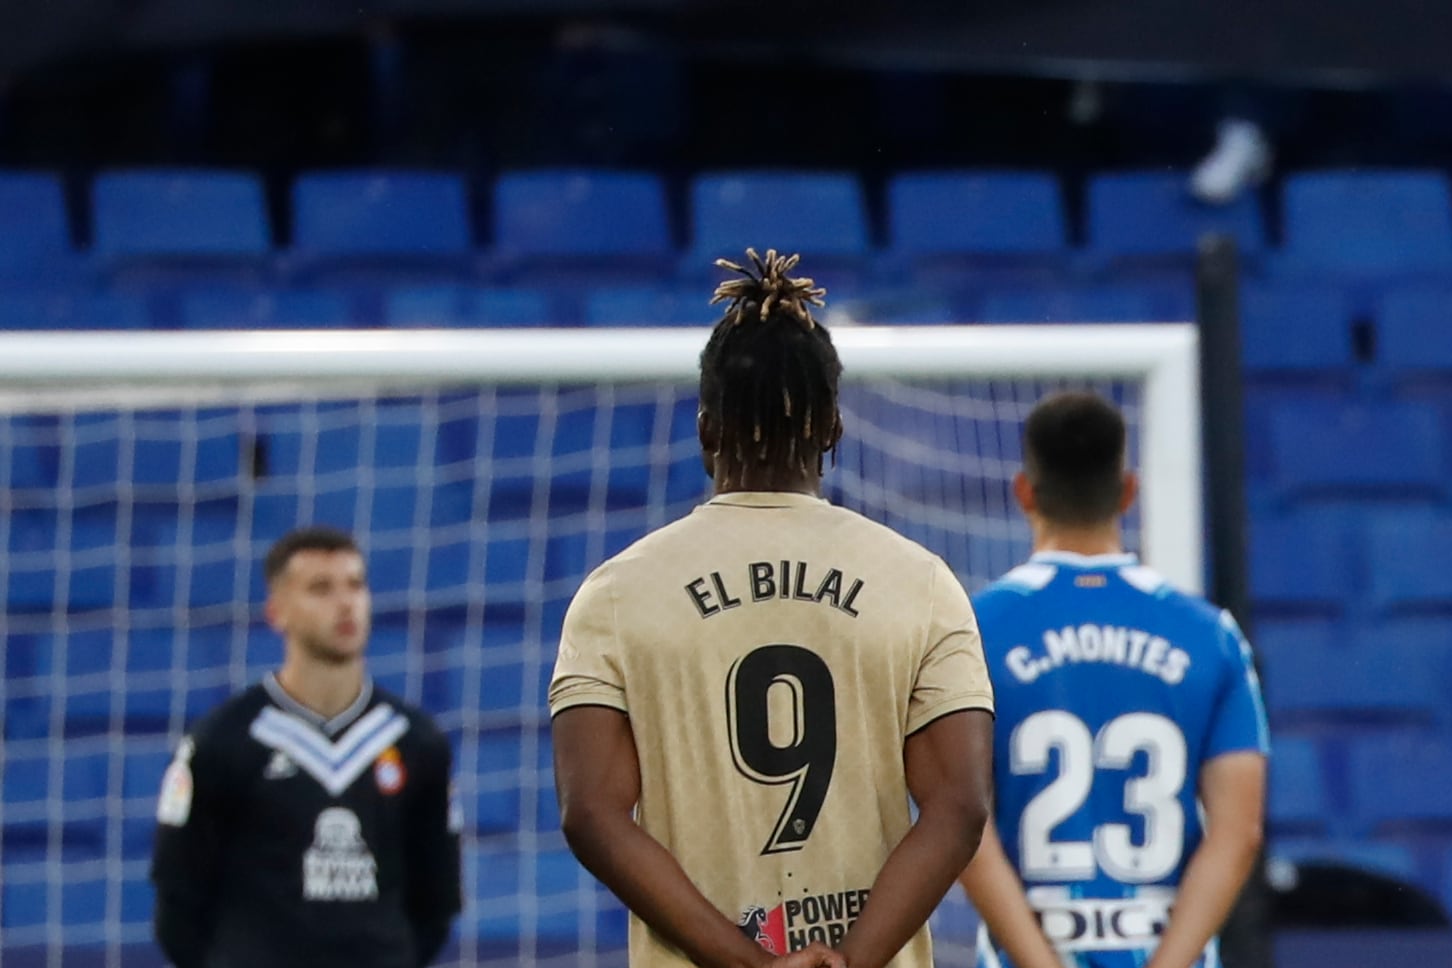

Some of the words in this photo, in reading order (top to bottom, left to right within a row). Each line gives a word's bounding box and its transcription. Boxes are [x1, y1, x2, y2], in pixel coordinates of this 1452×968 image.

[684, 572, 741, 618] EL
[749, 560, 865, 617] BILAL
[1006, 623, 1191, 685] C.MONTES
[725, 644, 837, 856] 9
[1009, 709, 1188, 883] 23
